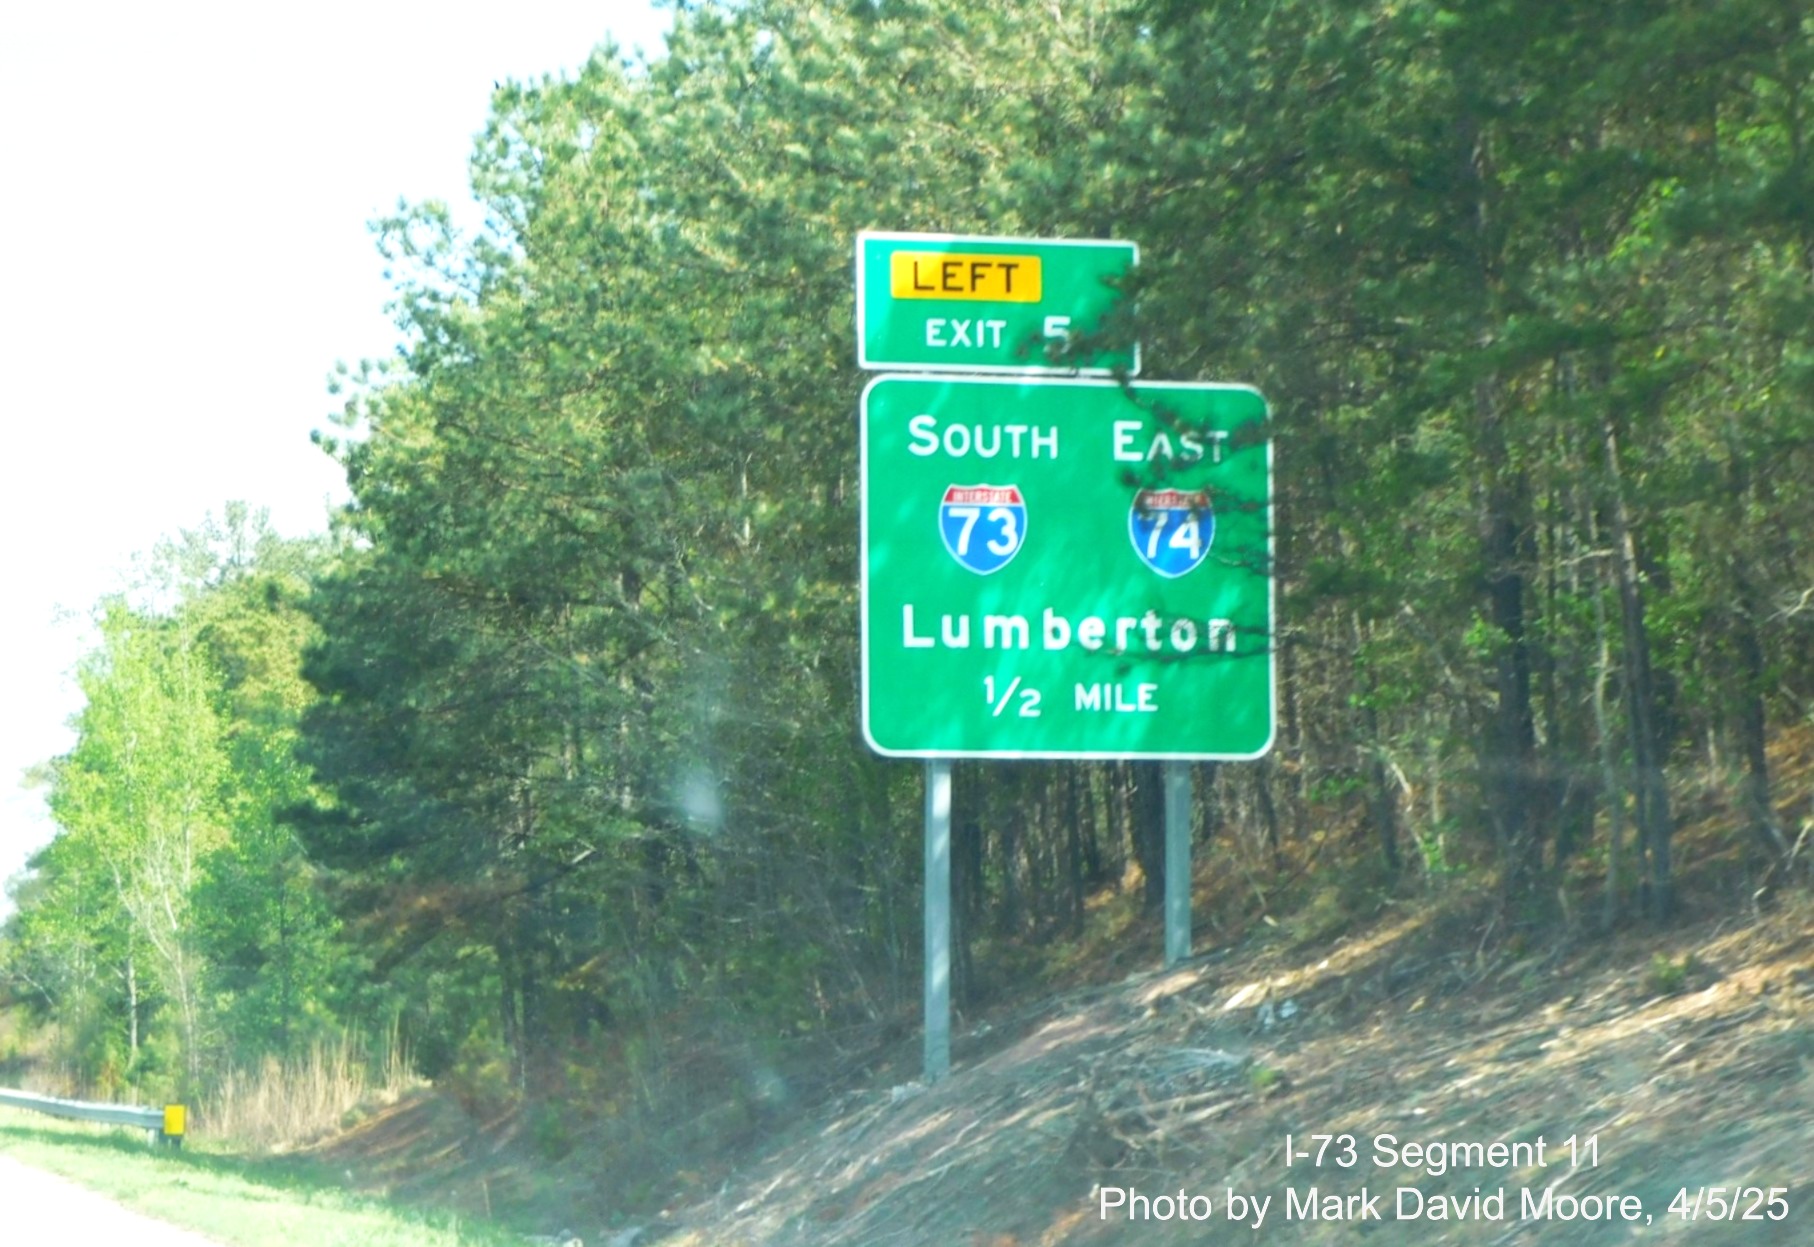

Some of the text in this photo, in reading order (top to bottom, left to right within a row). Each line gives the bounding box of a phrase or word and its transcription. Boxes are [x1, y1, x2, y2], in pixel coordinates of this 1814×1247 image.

[913, 260, 1019, 293] LEFT
[926, 318, 1007, 349] EXIT
[907, 414, 1229, 463] SOUTH EAST
[948, 507, 1019, 556] 73
[1138, 511, 1201, 560] 74
[902, 603, 1237, 654] Lumberton
[1074, 682, 1159, 712] MILE
